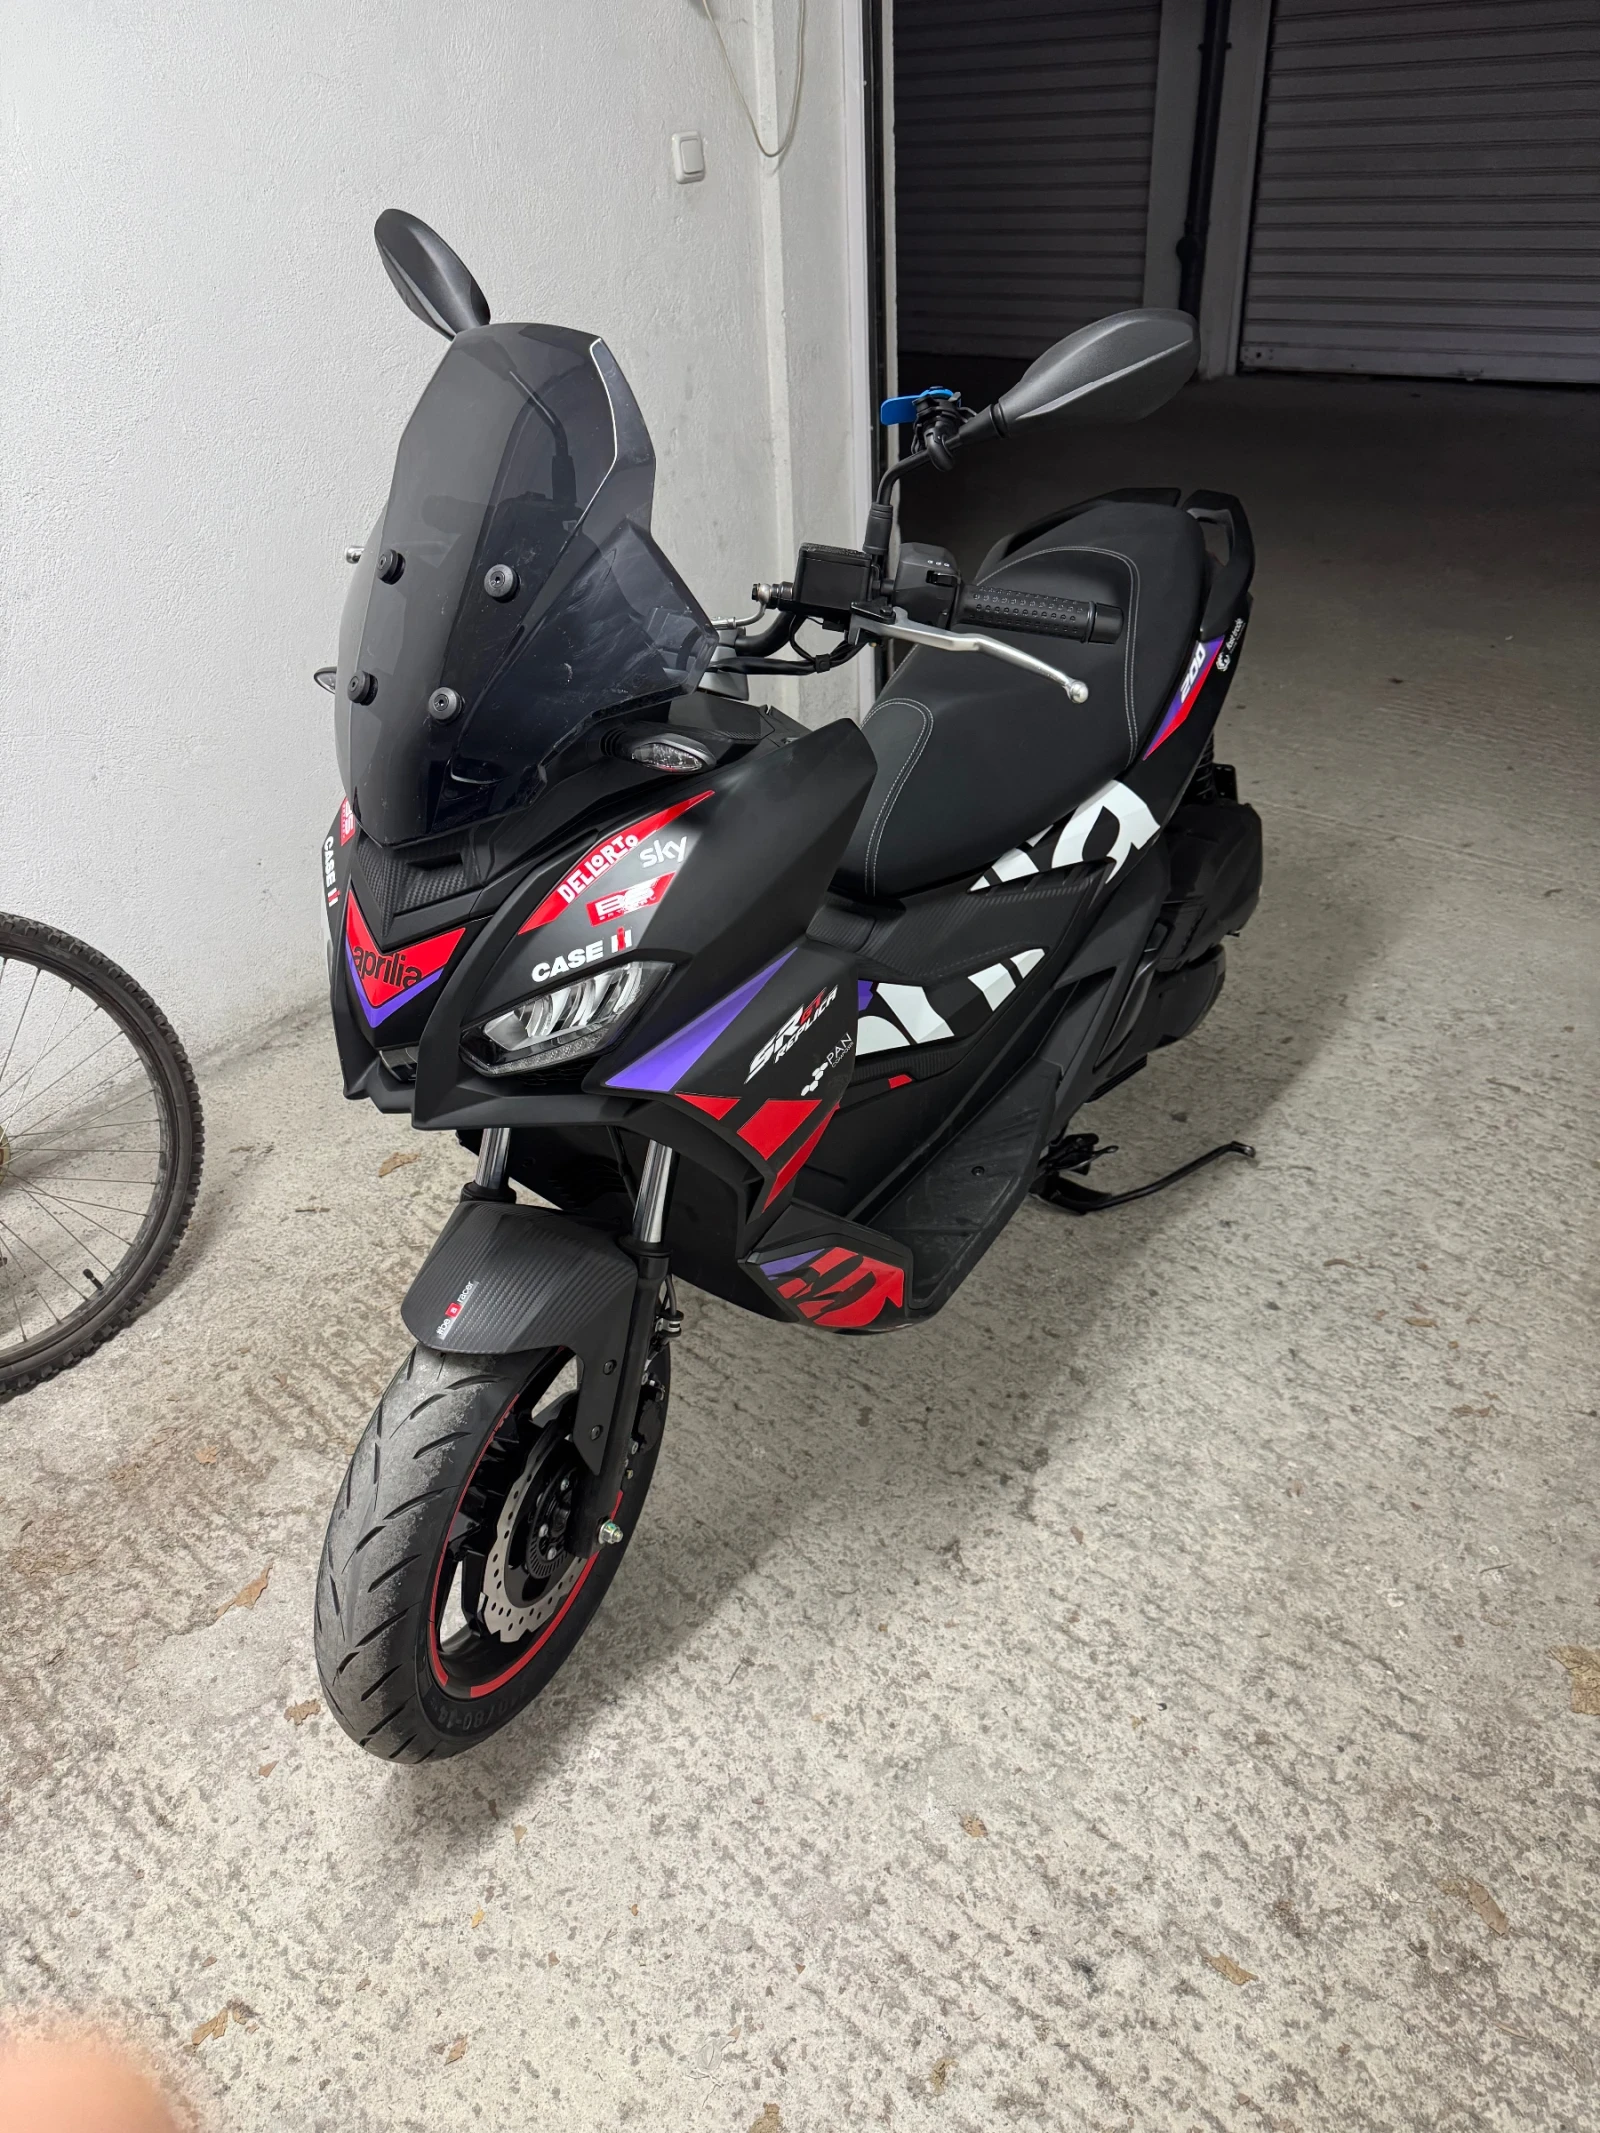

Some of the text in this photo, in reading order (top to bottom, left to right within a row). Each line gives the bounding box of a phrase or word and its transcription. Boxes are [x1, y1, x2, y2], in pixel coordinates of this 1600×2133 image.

[1180, 642, 1206, 704] 200
[324, 836, 336, 888] CASE
[557, 834, 639, 904] DELLORTO
[639, 836, 687, 869] sky
[353, 946, 423, 990] aprilia
[531, 940, 604, 983] CASE
[774, 985, 839, 1064] REPLICA
[826, 1032, 853, 1066] PAN
[435, 1318, 451, 1336] #be
[456, 1281, 474, 1303] racer
